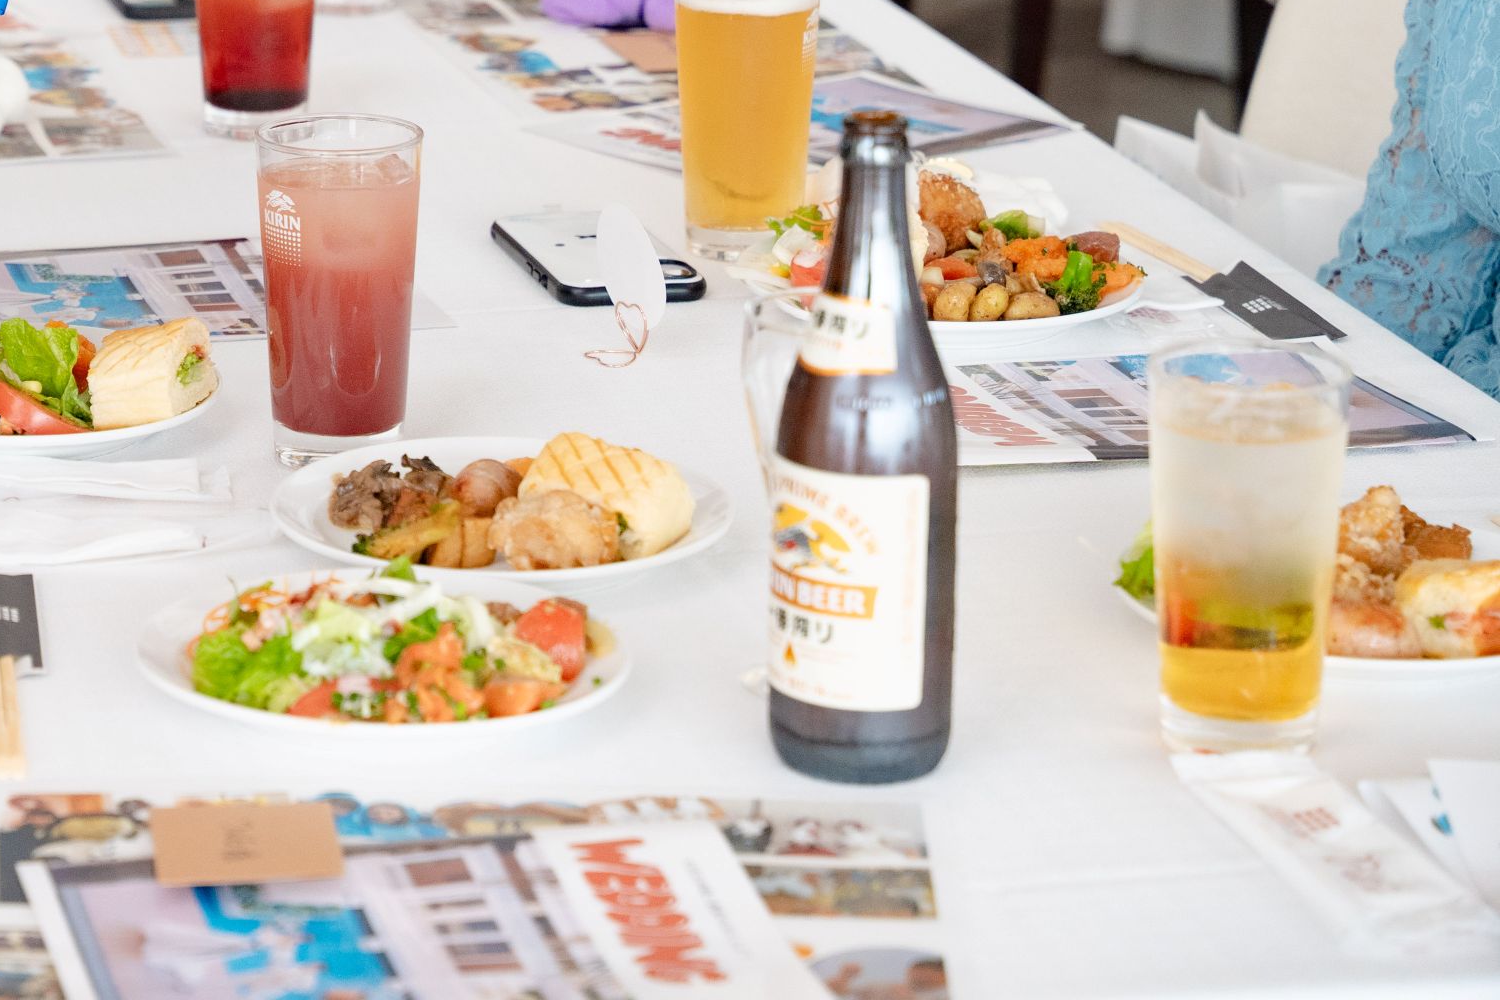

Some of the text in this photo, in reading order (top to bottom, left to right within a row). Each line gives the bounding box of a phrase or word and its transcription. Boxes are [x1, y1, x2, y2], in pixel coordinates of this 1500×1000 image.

[264, 208, 301, 232] KIRIN
[798, 579, 866, 617] BEER
[569, 834, 730, 984] WEDDING
